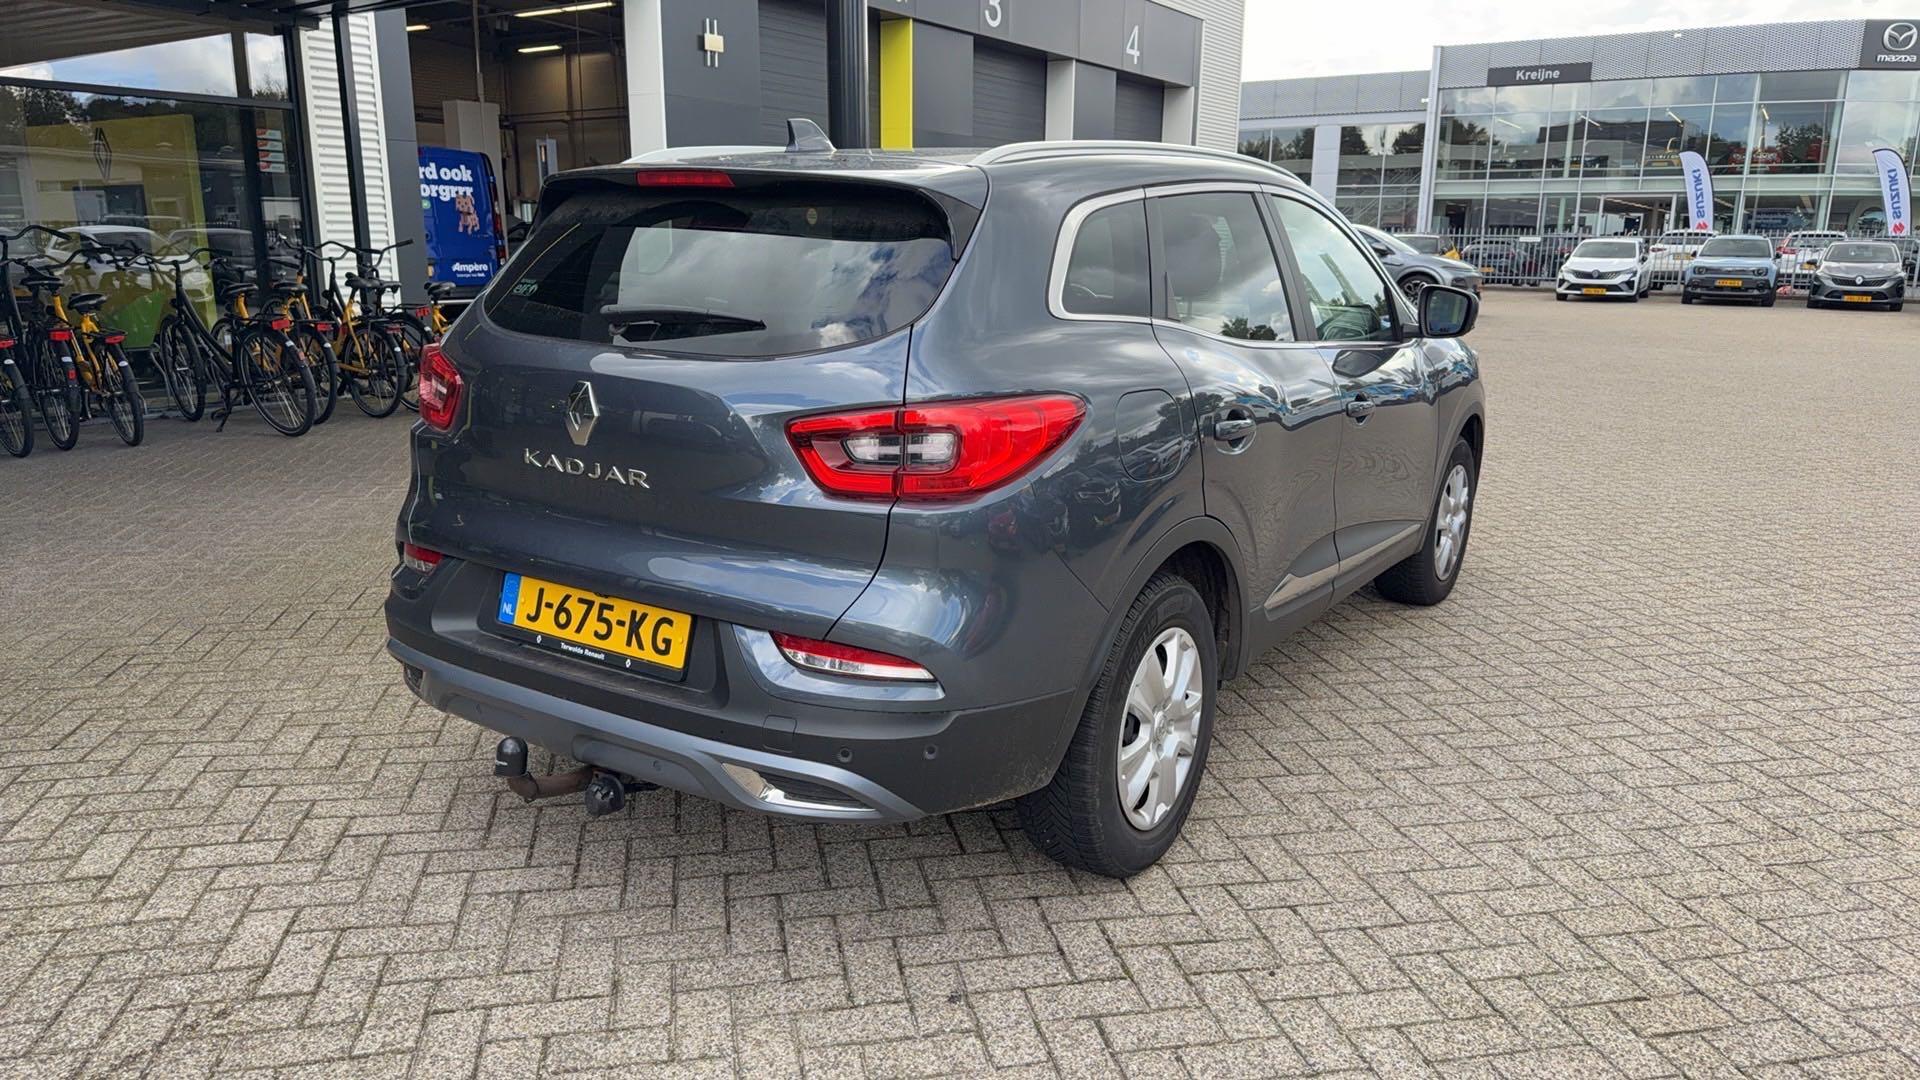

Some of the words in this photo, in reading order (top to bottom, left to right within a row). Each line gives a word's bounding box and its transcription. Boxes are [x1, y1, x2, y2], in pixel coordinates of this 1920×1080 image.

[1126, 25, 1140, 64] 4
[1515, 68, 1560, 82] Kreijne
[440, 164, 473, 182] ook
[523, 447, 650, 489] KADJAR
[503, 602, 514, 616] NL
[526, 587, 675, 656] J-675-KG
[584, 648, 606, 661] Renault
